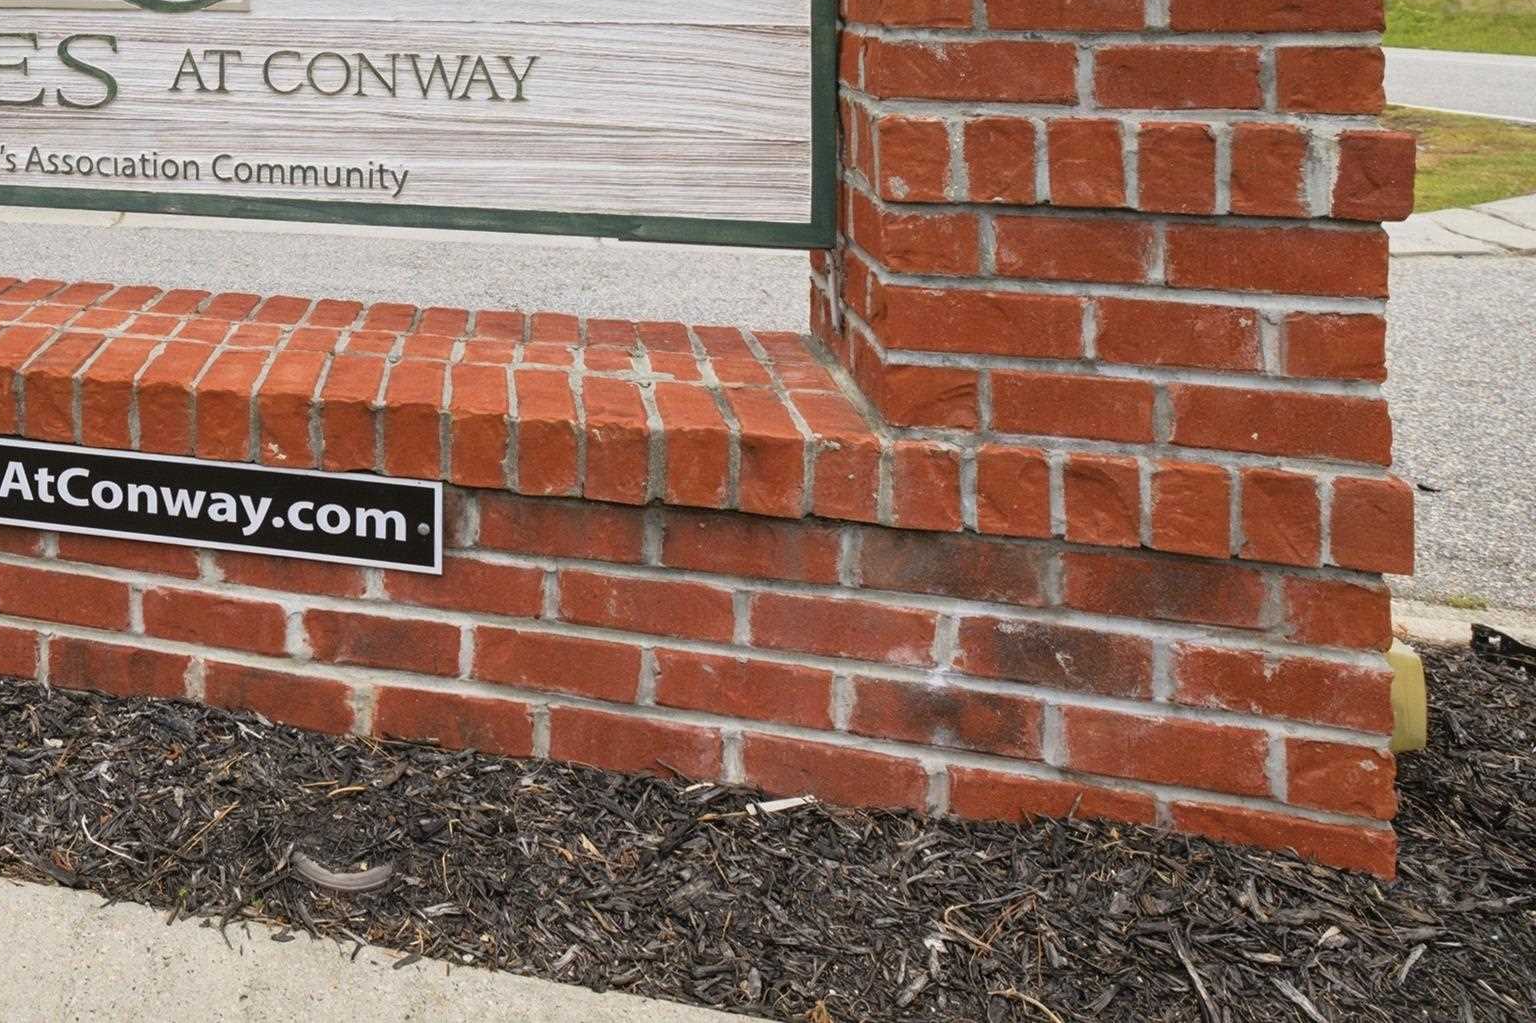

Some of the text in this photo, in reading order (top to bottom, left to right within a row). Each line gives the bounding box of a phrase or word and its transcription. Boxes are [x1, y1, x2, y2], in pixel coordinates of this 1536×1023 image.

[169, 48, 242, 94] AT
[263, 50, 540, 102] CONWAY
[25, 145, 200, 181] Association
[211, 154, 410, 198] Community
